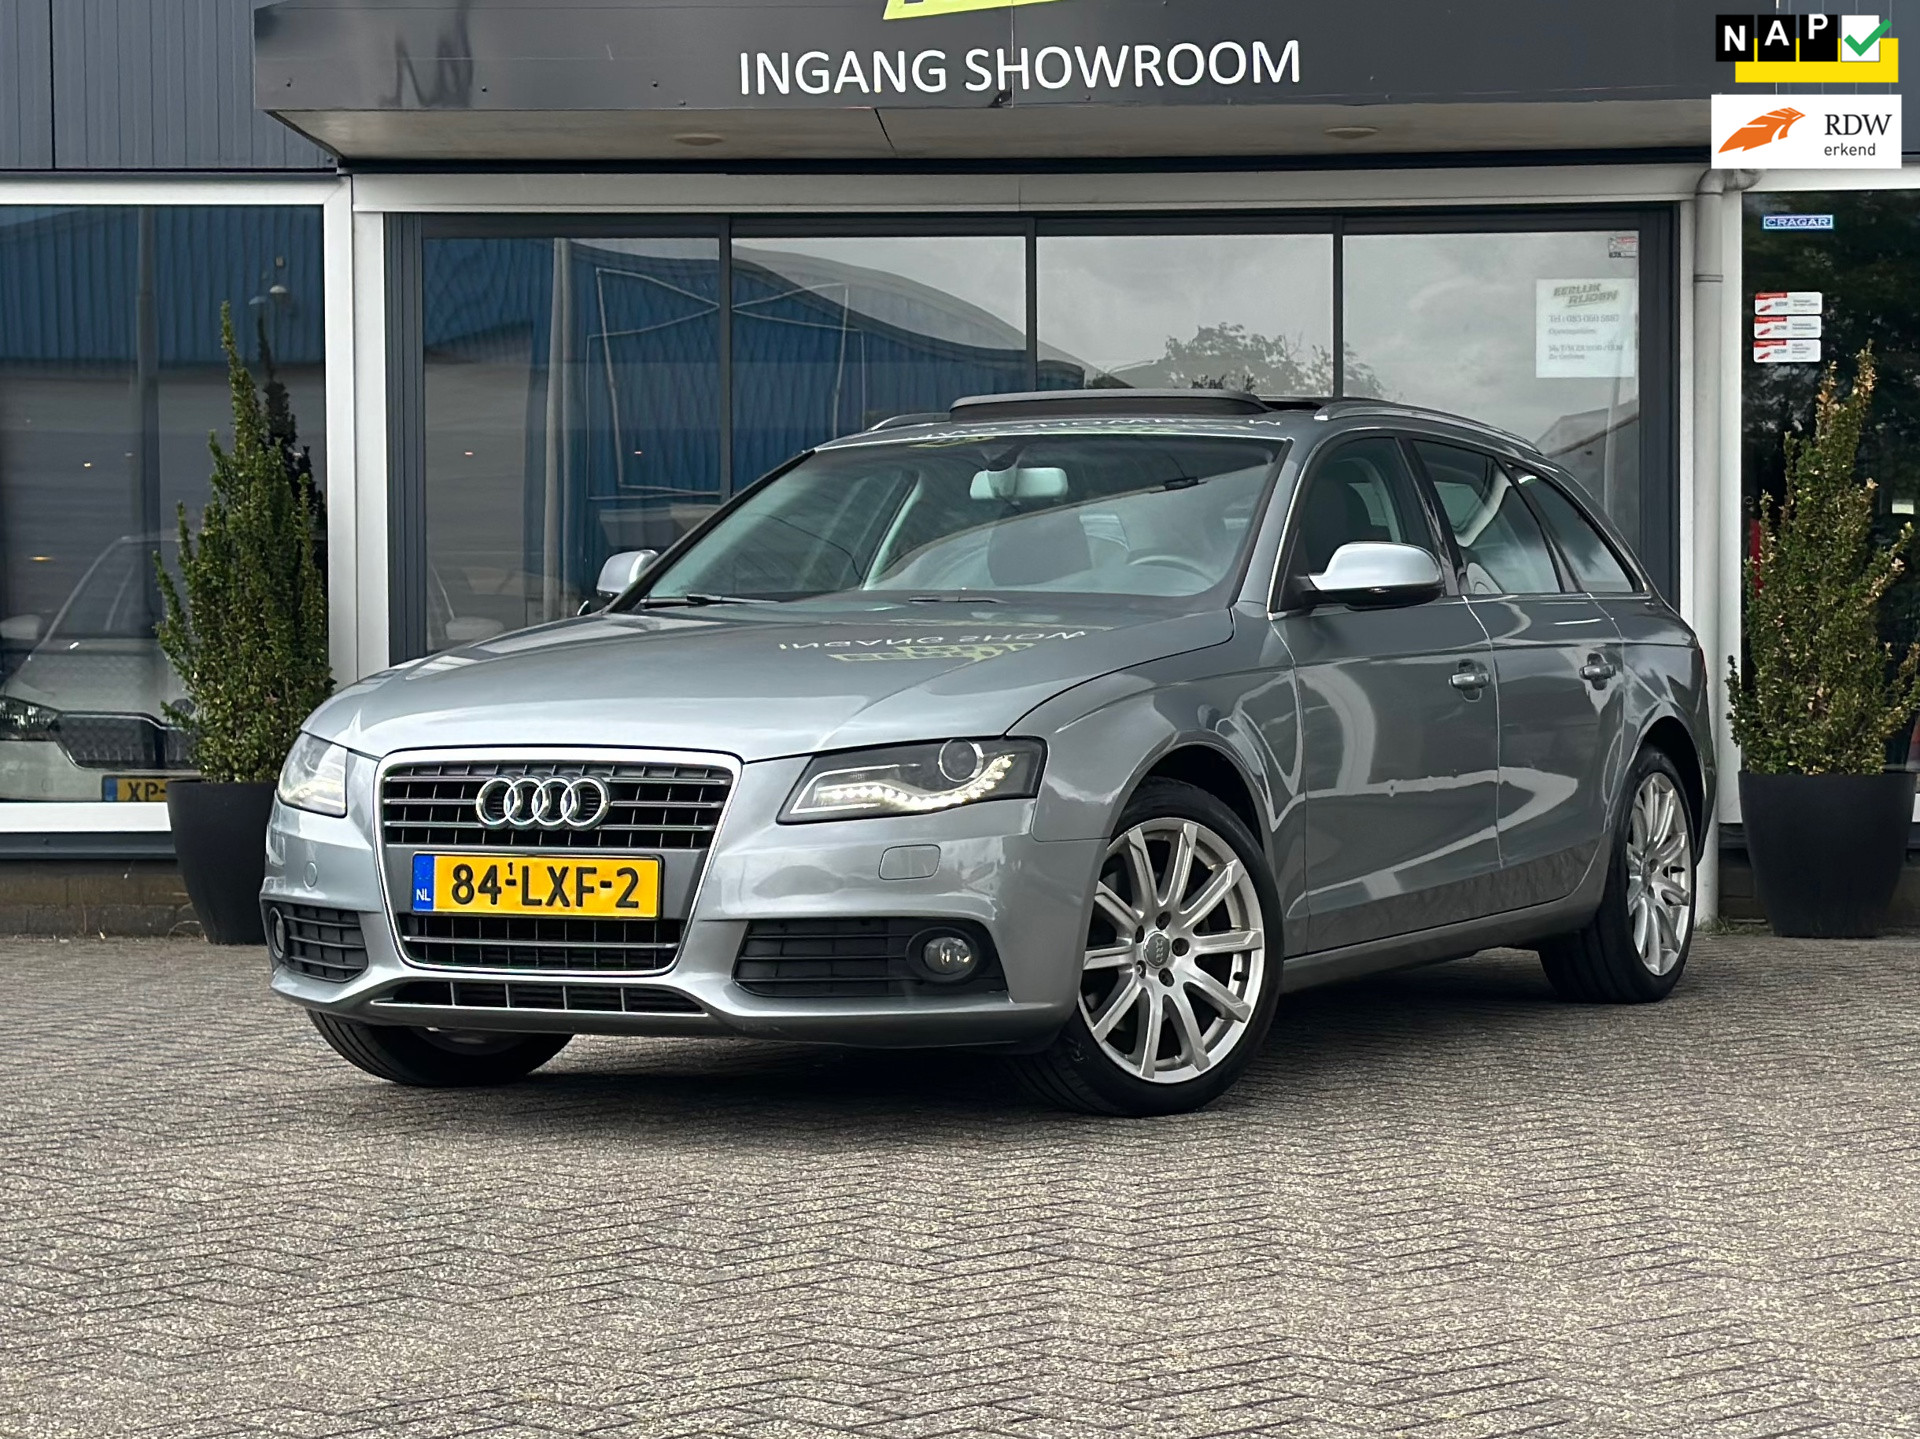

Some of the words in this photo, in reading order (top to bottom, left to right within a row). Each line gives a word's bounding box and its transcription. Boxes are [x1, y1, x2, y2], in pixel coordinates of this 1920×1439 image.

[739, 49, 948, 96] INGANG
[964, 39, 1301, 92] SHOWROOM
[1764, 217, 1830, 228] CRAGAR
[415, 888, 431, 902] NL
[451, 863, 640, 909] 84-LXF-2
